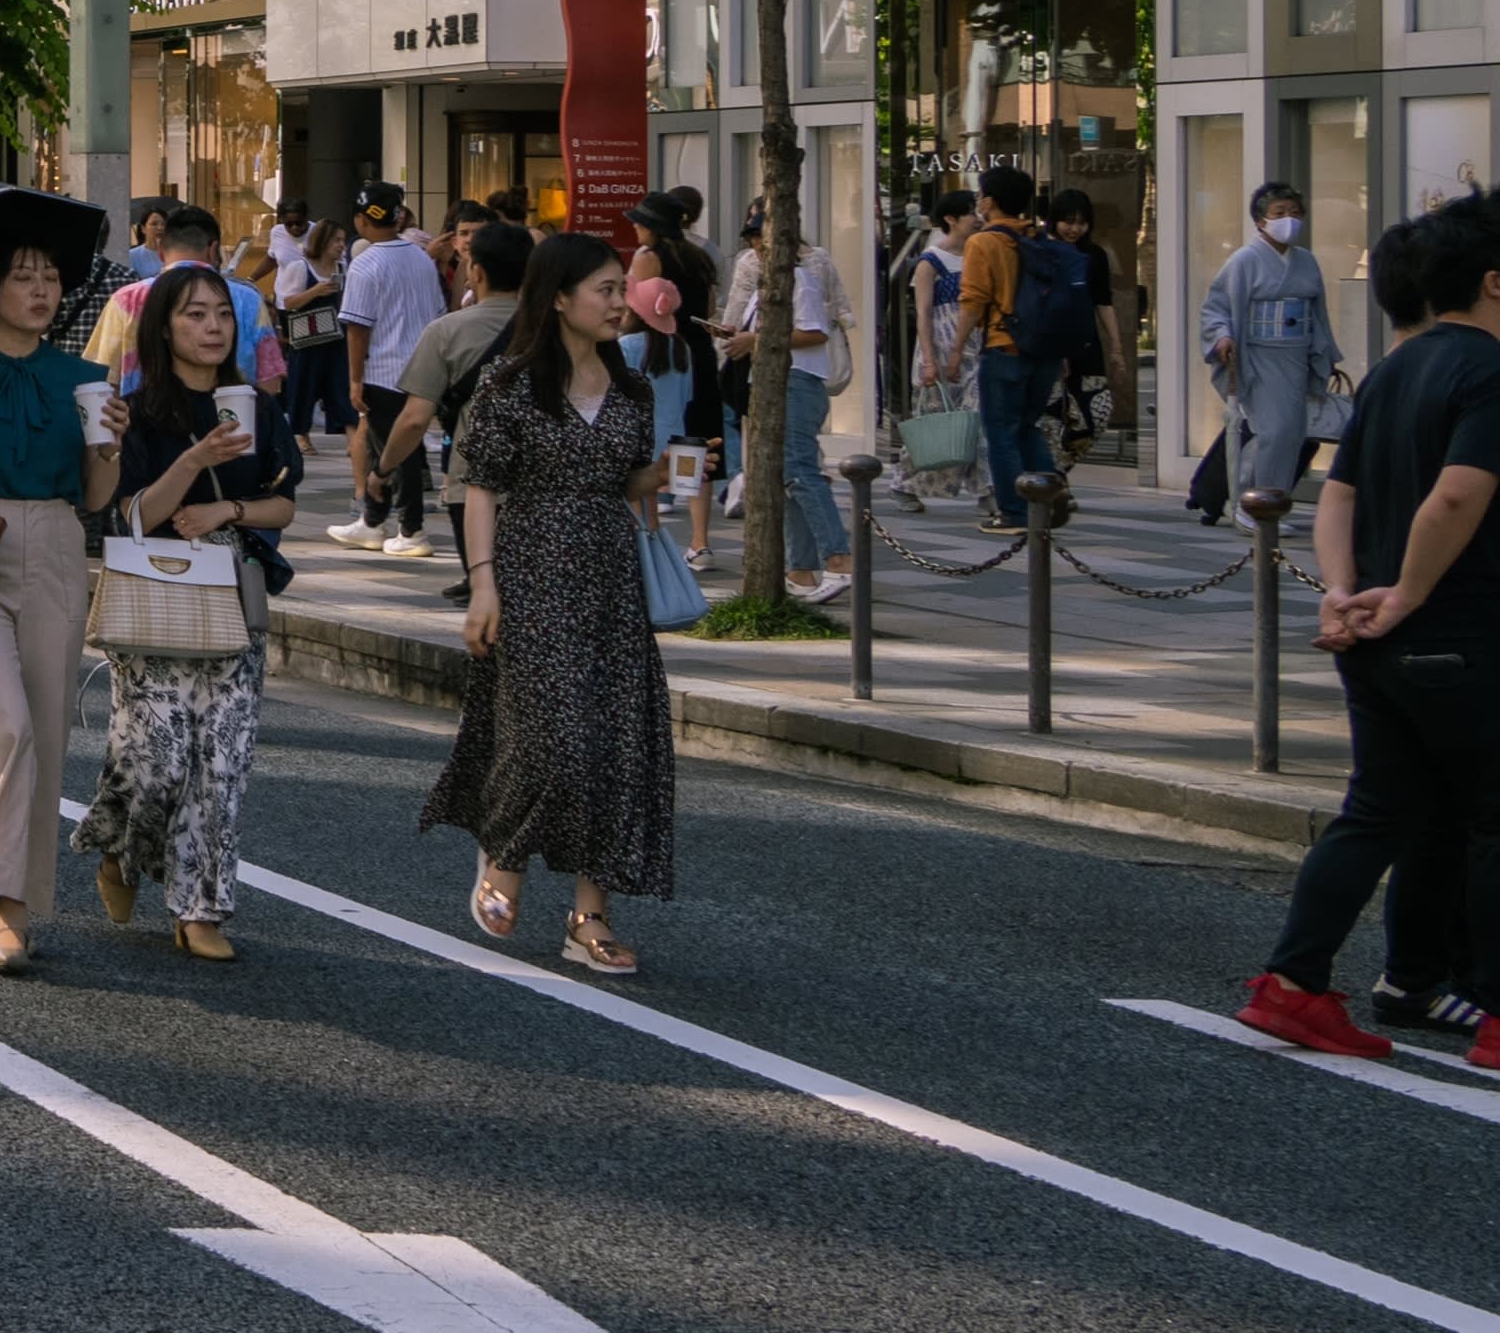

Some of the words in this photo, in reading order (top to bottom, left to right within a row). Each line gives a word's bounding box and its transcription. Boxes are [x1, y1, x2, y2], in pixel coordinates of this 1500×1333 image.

[425, 12, 479, 49] 大黒屋
[573, 154, 581, 163] 7
[909, 153, 1019, 172] TASAKI
[577, 185, 586, 194] 5
[588, 185, 609, 194] DaB
[610, 185, 645, 194] GINZA
